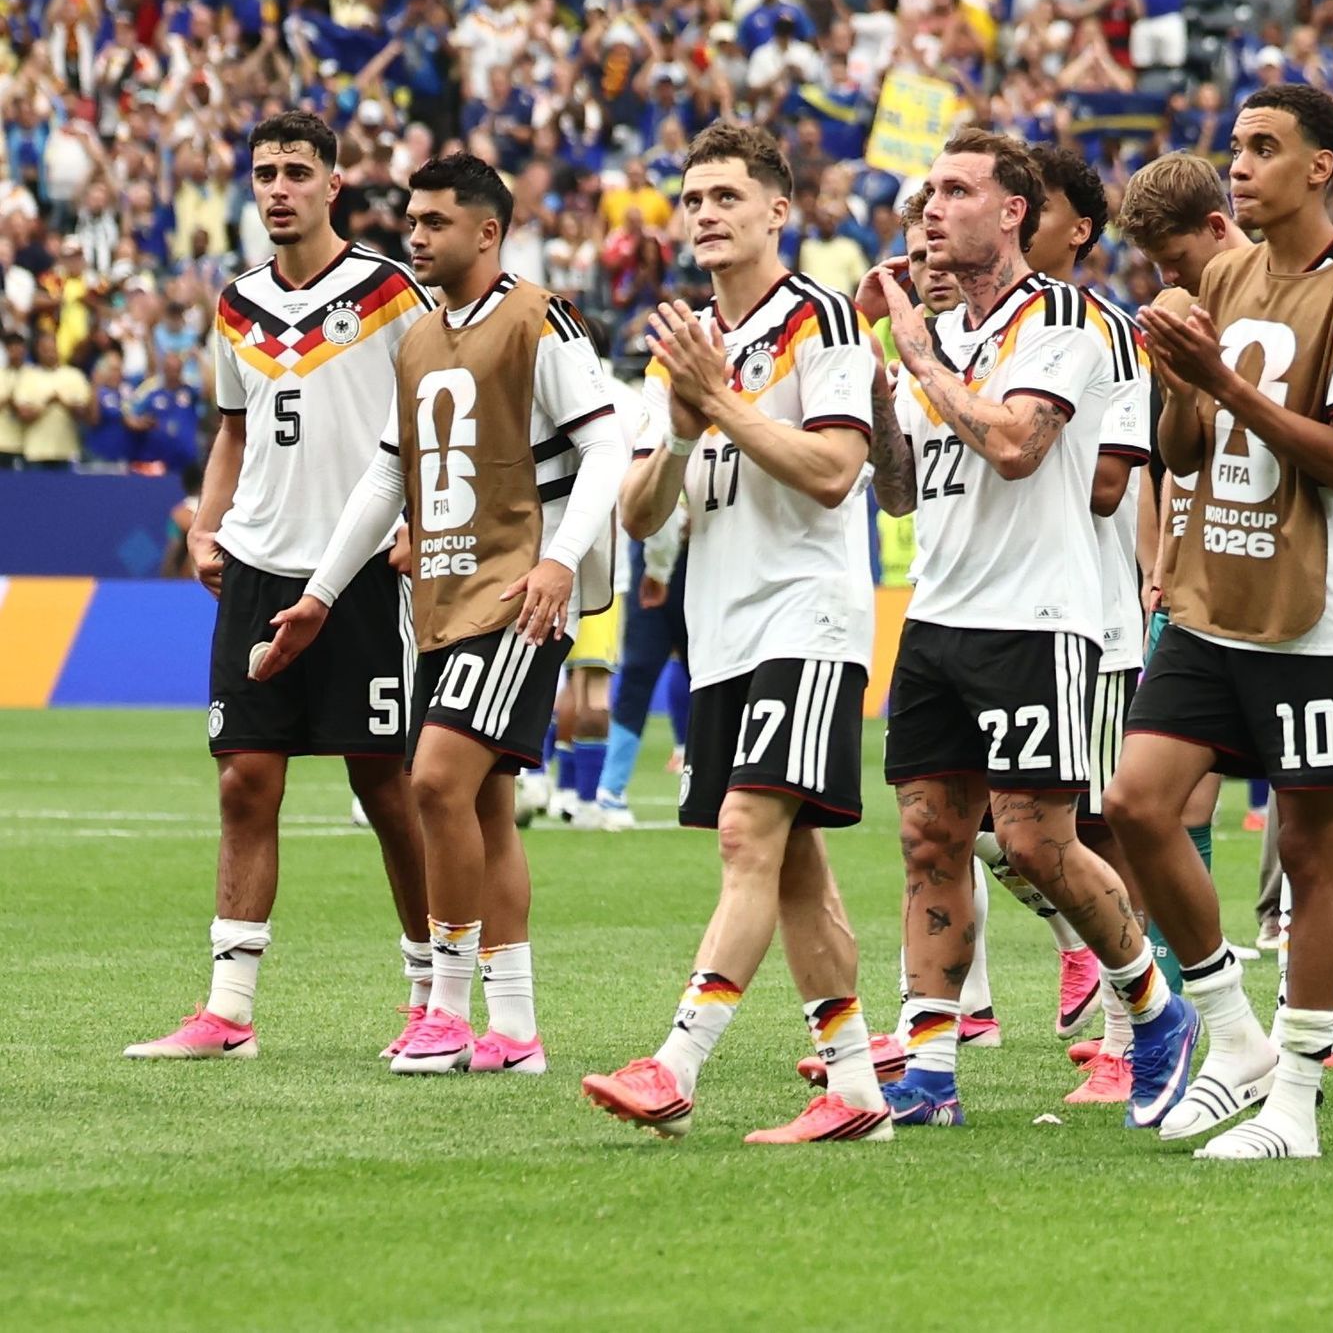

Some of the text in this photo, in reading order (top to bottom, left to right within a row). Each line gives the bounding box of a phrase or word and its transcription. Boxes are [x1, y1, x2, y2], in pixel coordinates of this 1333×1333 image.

[275, 389, 301, 446] 5
[703, 443, 740, 512] 17
[922, 435, 965, 501] 22
[1218, 464, 1251, 486] FIFA
[1240, 510, 1279, 529] CUP
[443, 534, 478, 550] CUP
[1204, 524, 1276, 559] 2026
[369, 677, 399, 735] 5
[731, 699, 786, 767] 17
[978, 704, 1052, 771] 22
[1150, 945, 1168, 958] FB
[480, 964, 493, 974] FB
[679, 1007, 697, 1020] FB
[817, 1046, 836, 1059] FB
